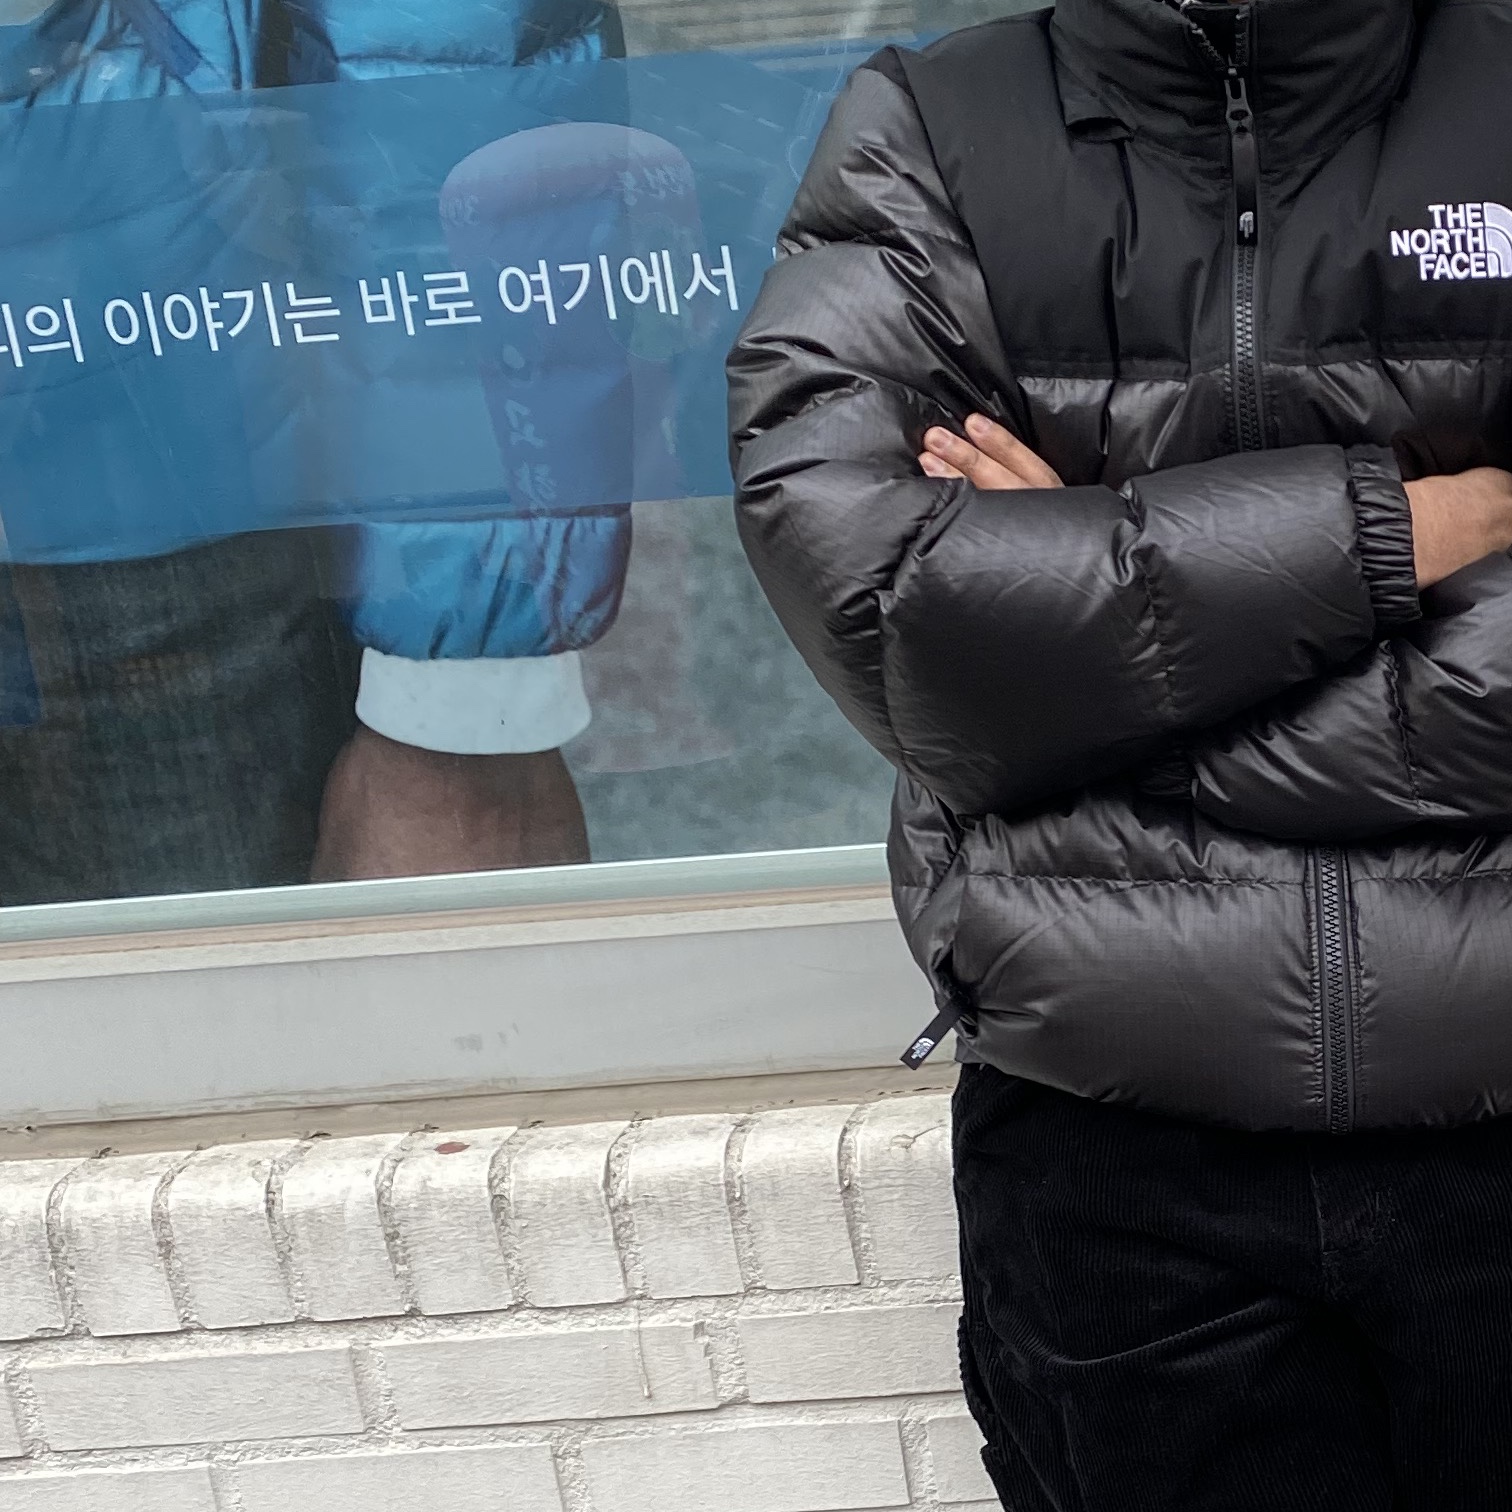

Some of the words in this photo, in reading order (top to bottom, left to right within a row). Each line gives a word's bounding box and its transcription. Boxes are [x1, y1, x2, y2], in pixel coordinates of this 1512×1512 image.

[1427, 203, 1484, 229] THE
[1390, 228, 1486, 256] NORTH
[1419, 252, 1487, 281] FACE
[103, 281, 341, 356] 이야기는
[358, 270, 482, 336] 바로
[498, 244, 740, 325] 여기에서
